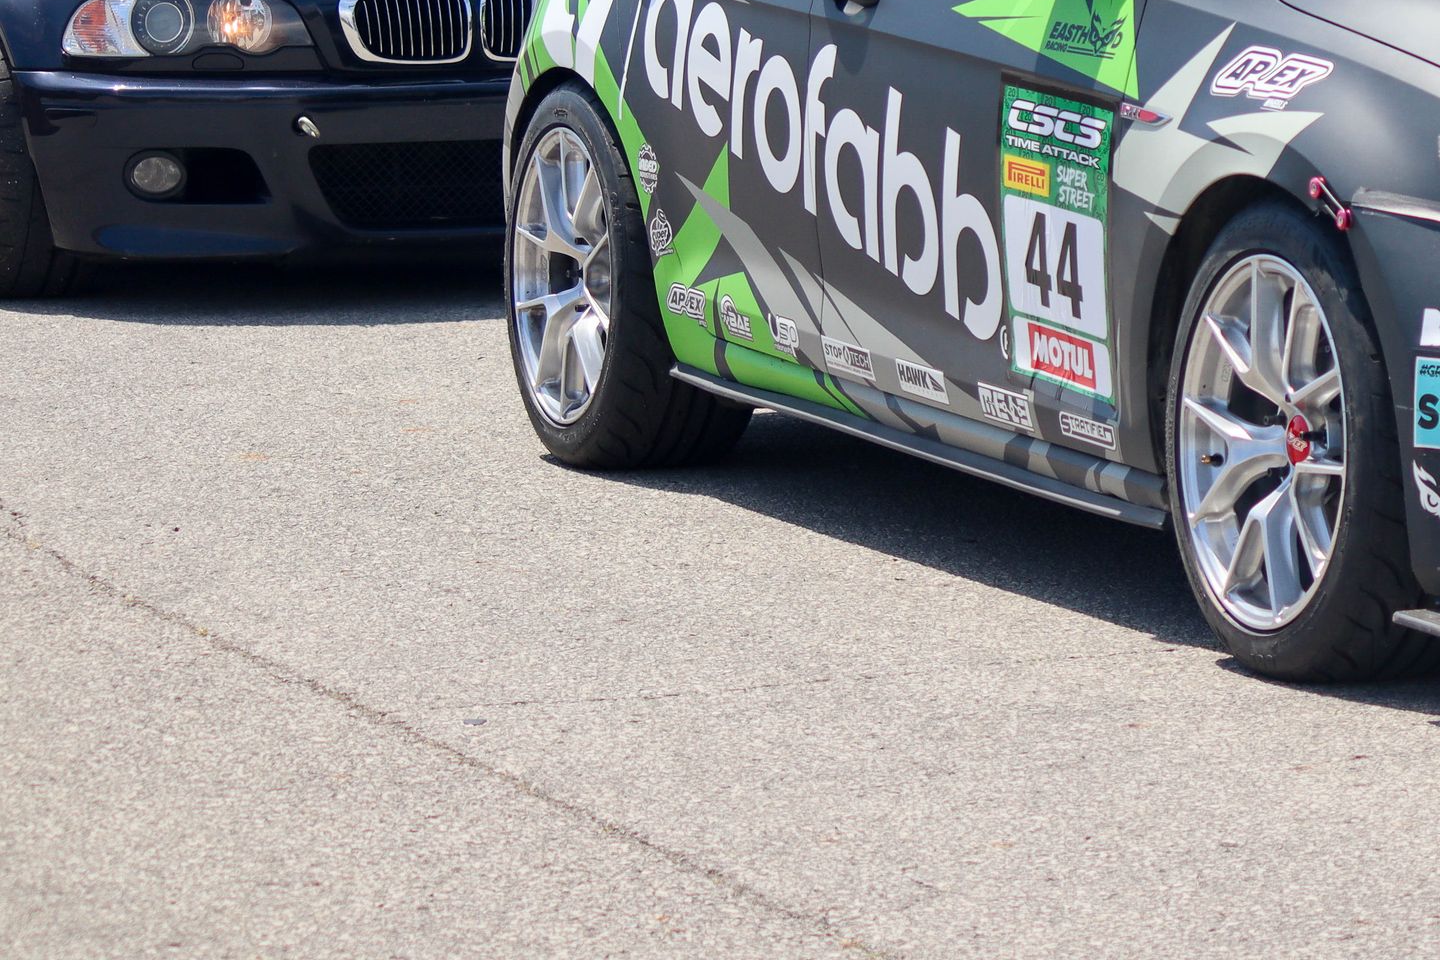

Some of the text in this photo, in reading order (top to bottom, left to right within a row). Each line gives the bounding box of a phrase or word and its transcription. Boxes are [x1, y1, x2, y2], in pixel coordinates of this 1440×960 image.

[1007, 99, 1106, 150] CSCS
[1005, 134, 1101, 169] TIME ATTACK
[1007, 160, 1046, 190] PIRELLI
[1056, 165, 1088, 192] SUPER
[1058, 185, 1096, 213] STREET
[1024, 211, 1084, 320] 44
[1033, 332, 1094, 380] MOTUL
[897, 363, 930, 390] HAWK
